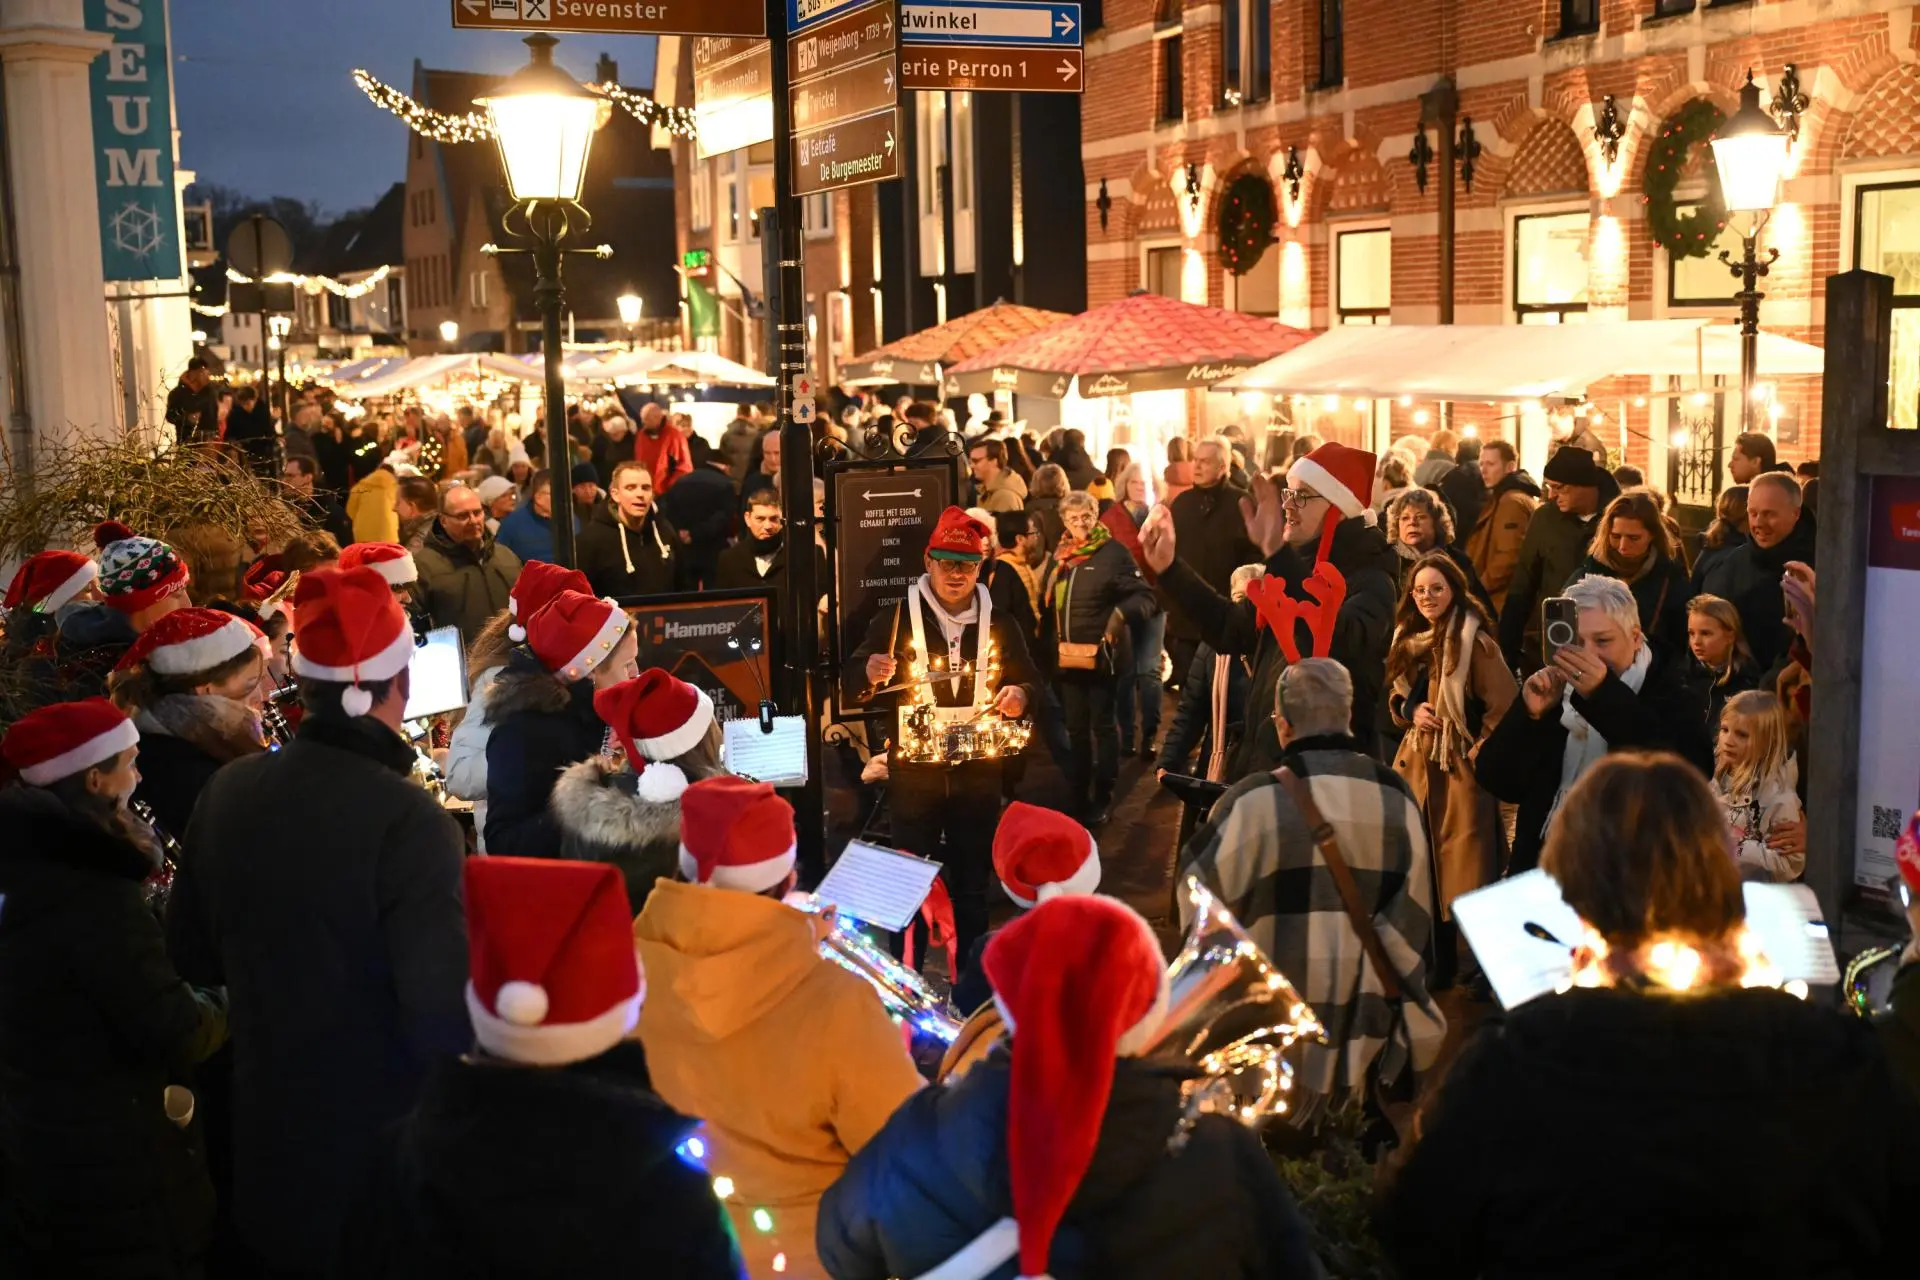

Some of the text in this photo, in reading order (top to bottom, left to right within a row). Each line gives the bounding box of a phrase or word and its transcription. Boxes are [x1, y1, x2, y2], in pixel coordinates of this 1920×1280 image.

[556, 0, 669, 20] Sevenster
[901, 11, 977, 30] dwinkel
[818, 30, 859, 58] Weijenborg
[865, 22, 880, 41] 1739
[902, 58, 1028, 78] erie Perron 1
[808, 87, 837, 113] Twickel
[810, 133, 836, 158] Eetcafé
[820, 152, 883, 182] De Burgemeester
[859, 516, 922, 529] GEMAAKT APPELGEBAK
[865, 507, 916, 519] KOFFIE MET EIGEN
[882, 538, 900, 546] LUNCH
[860, 579, 864, 588] 3
[866, 578, 888, 588] GANGEN
[889, 577, 907, 586] KEUZE
[665, 621, 737, 640] Hammer
